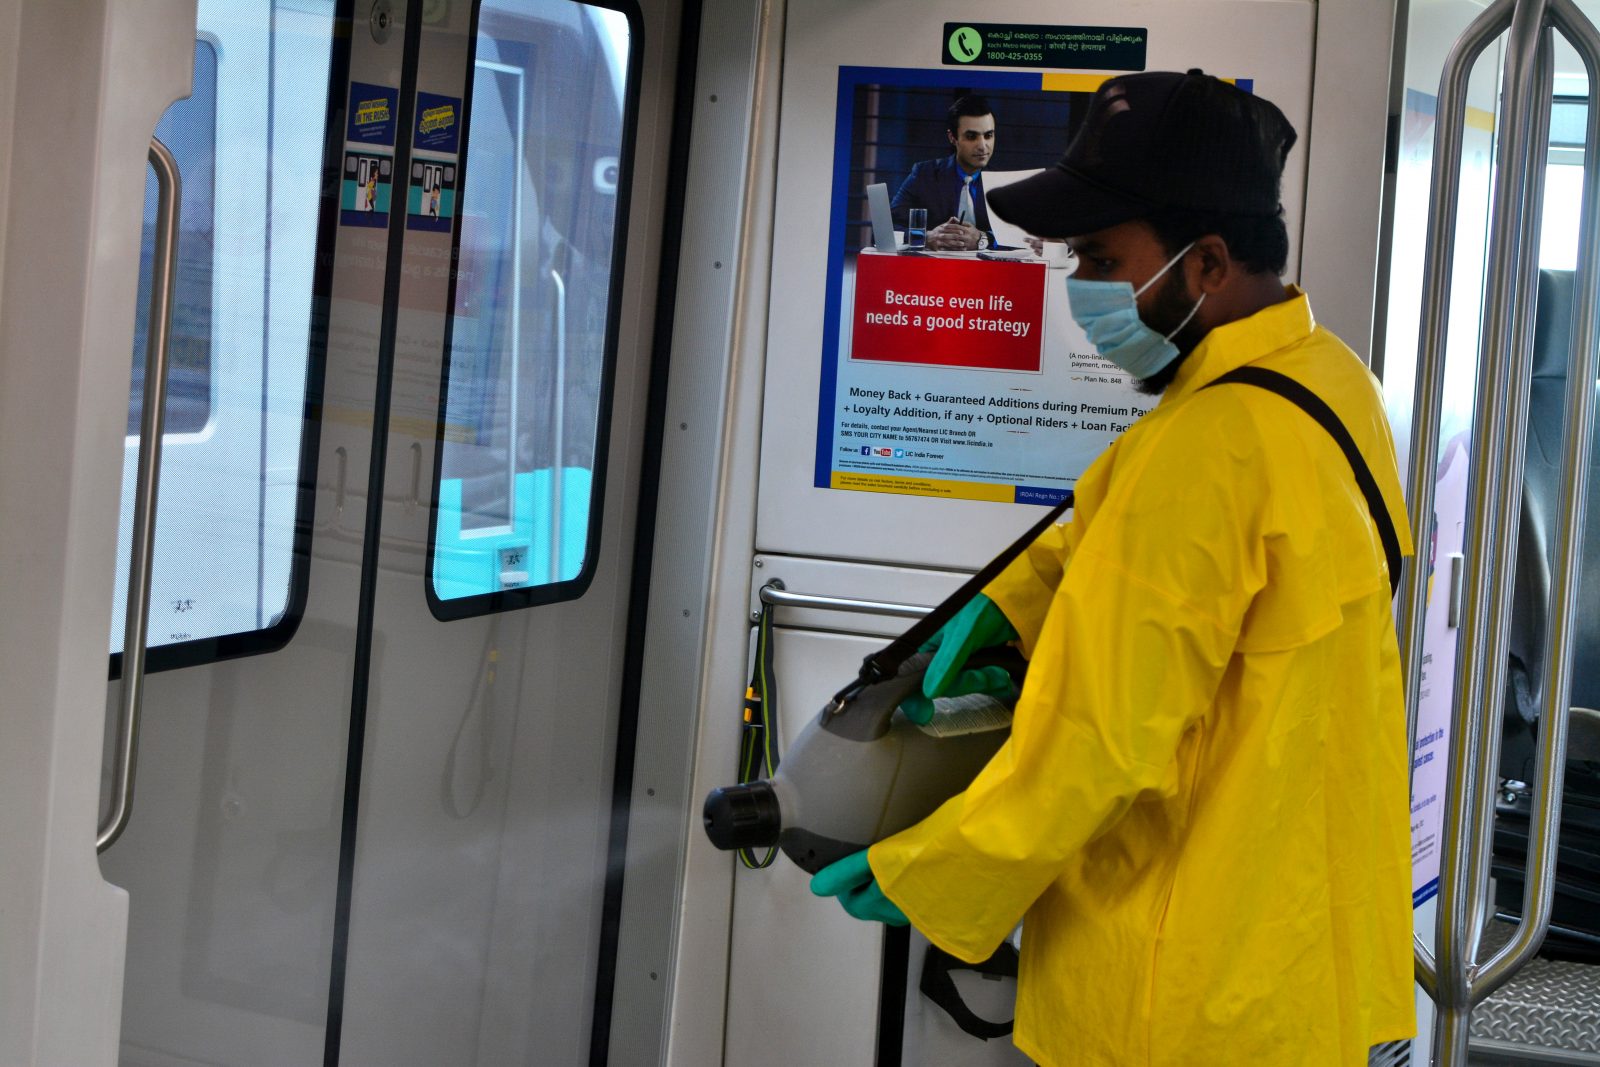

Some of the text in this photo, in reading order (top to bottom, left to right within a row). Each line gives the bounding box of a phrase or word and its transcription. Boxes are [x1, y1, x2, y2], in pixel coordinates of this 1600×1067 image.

[987, 52, 1043, 60] 1800-425-0355
[885, 290, 1013, 311] Because even life
[866, 311, 1031, 337] needs a good strategy
[1071, 361, 1100, 369] payment,
[849, 387, 885, 401] Money
[888, 390, 912, 401] Back
[924, 393, 985, 406] Guaranteed
[988, 396, 1039, 410] Additions
[1042, 400, 1077, 415] during
[1081, 403, 1128, 416] Premium
[853, 404, 891, 418] Loyalty
[893, 407, 941, 420] Addition,
[944, 409, 952, 420] if
[955, 414, 974, 424] any
[986, 413, 1032, 426] Optional
[1036, 417, 1068, 428] Riders
[1081, 420, 1107, 431] Loan
[850, 422, 869, 430] details,
[902, 426, 938, 434] Agent/Nearest
[1035, 492, 1048, 500] Regn
